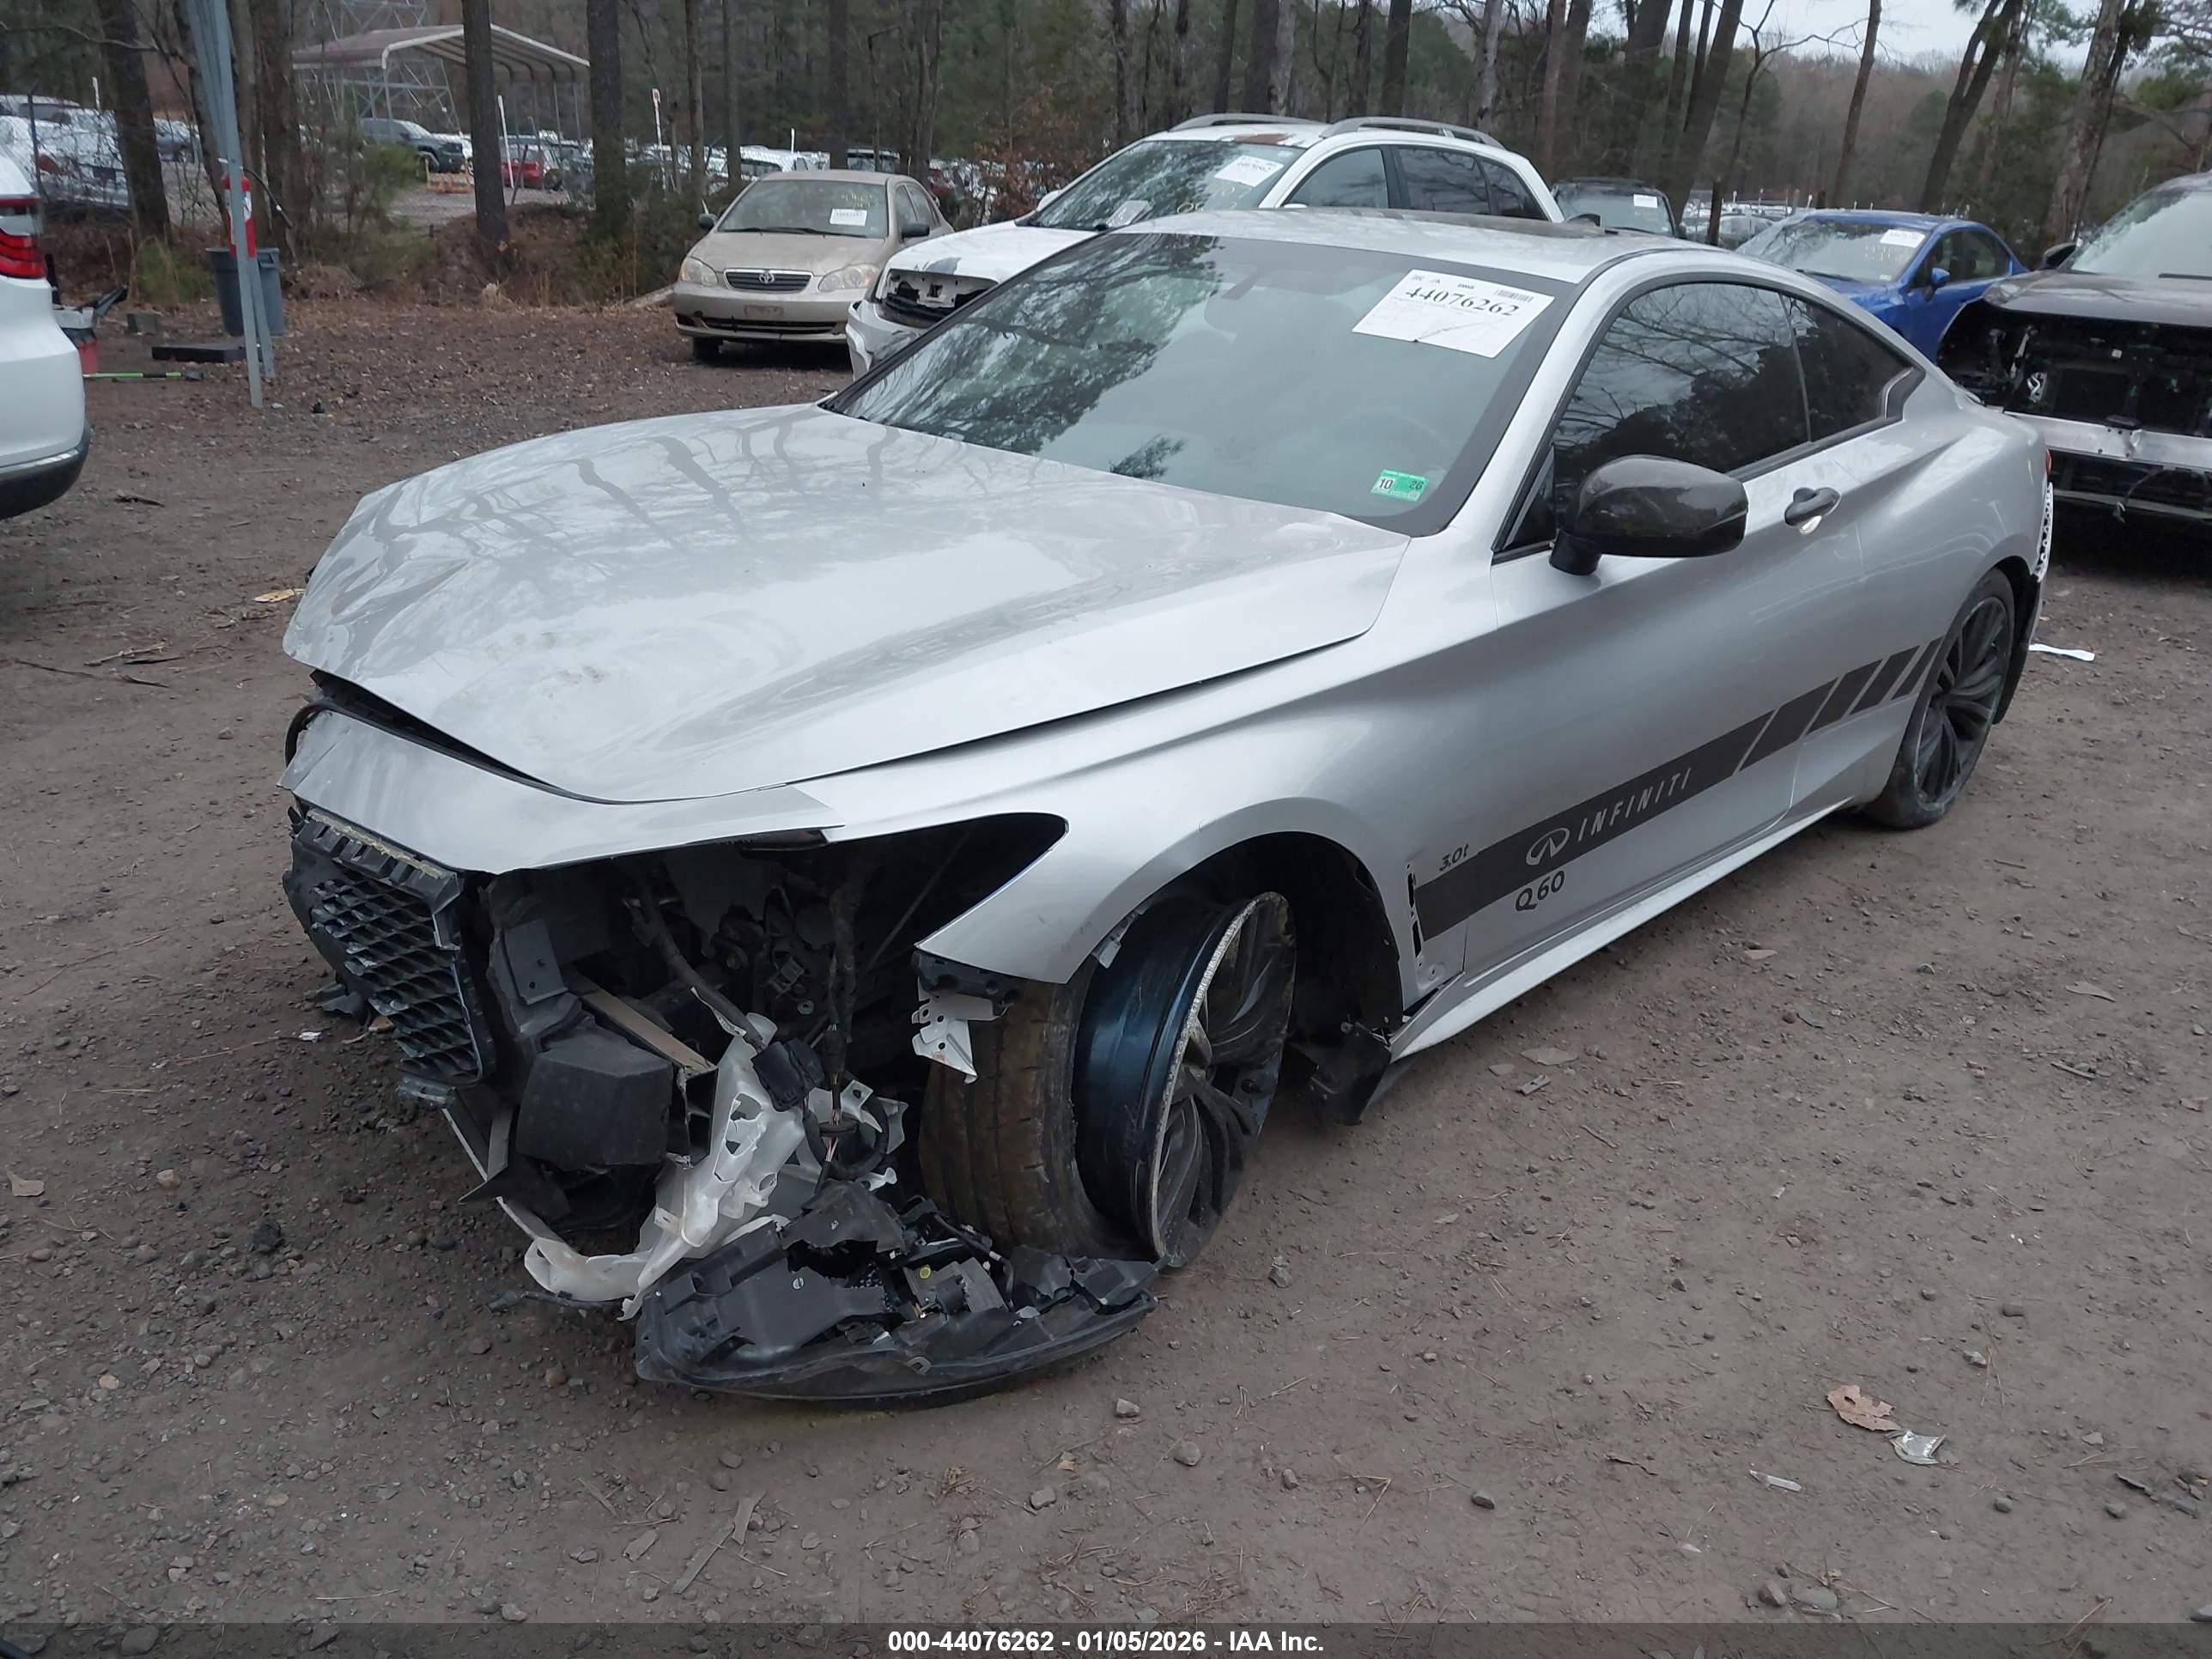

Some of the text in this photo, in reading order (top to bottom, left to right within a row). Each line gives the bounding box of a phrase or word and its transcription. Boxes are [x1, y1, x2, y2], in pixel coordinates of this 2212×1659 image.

[1405, 287, 1520, 316] 44076262
[1378, 477, 1395, 489] 10
[1577, 768, 1692, 842] INFINITI
[1515, 870, 1565, 912] Q60
